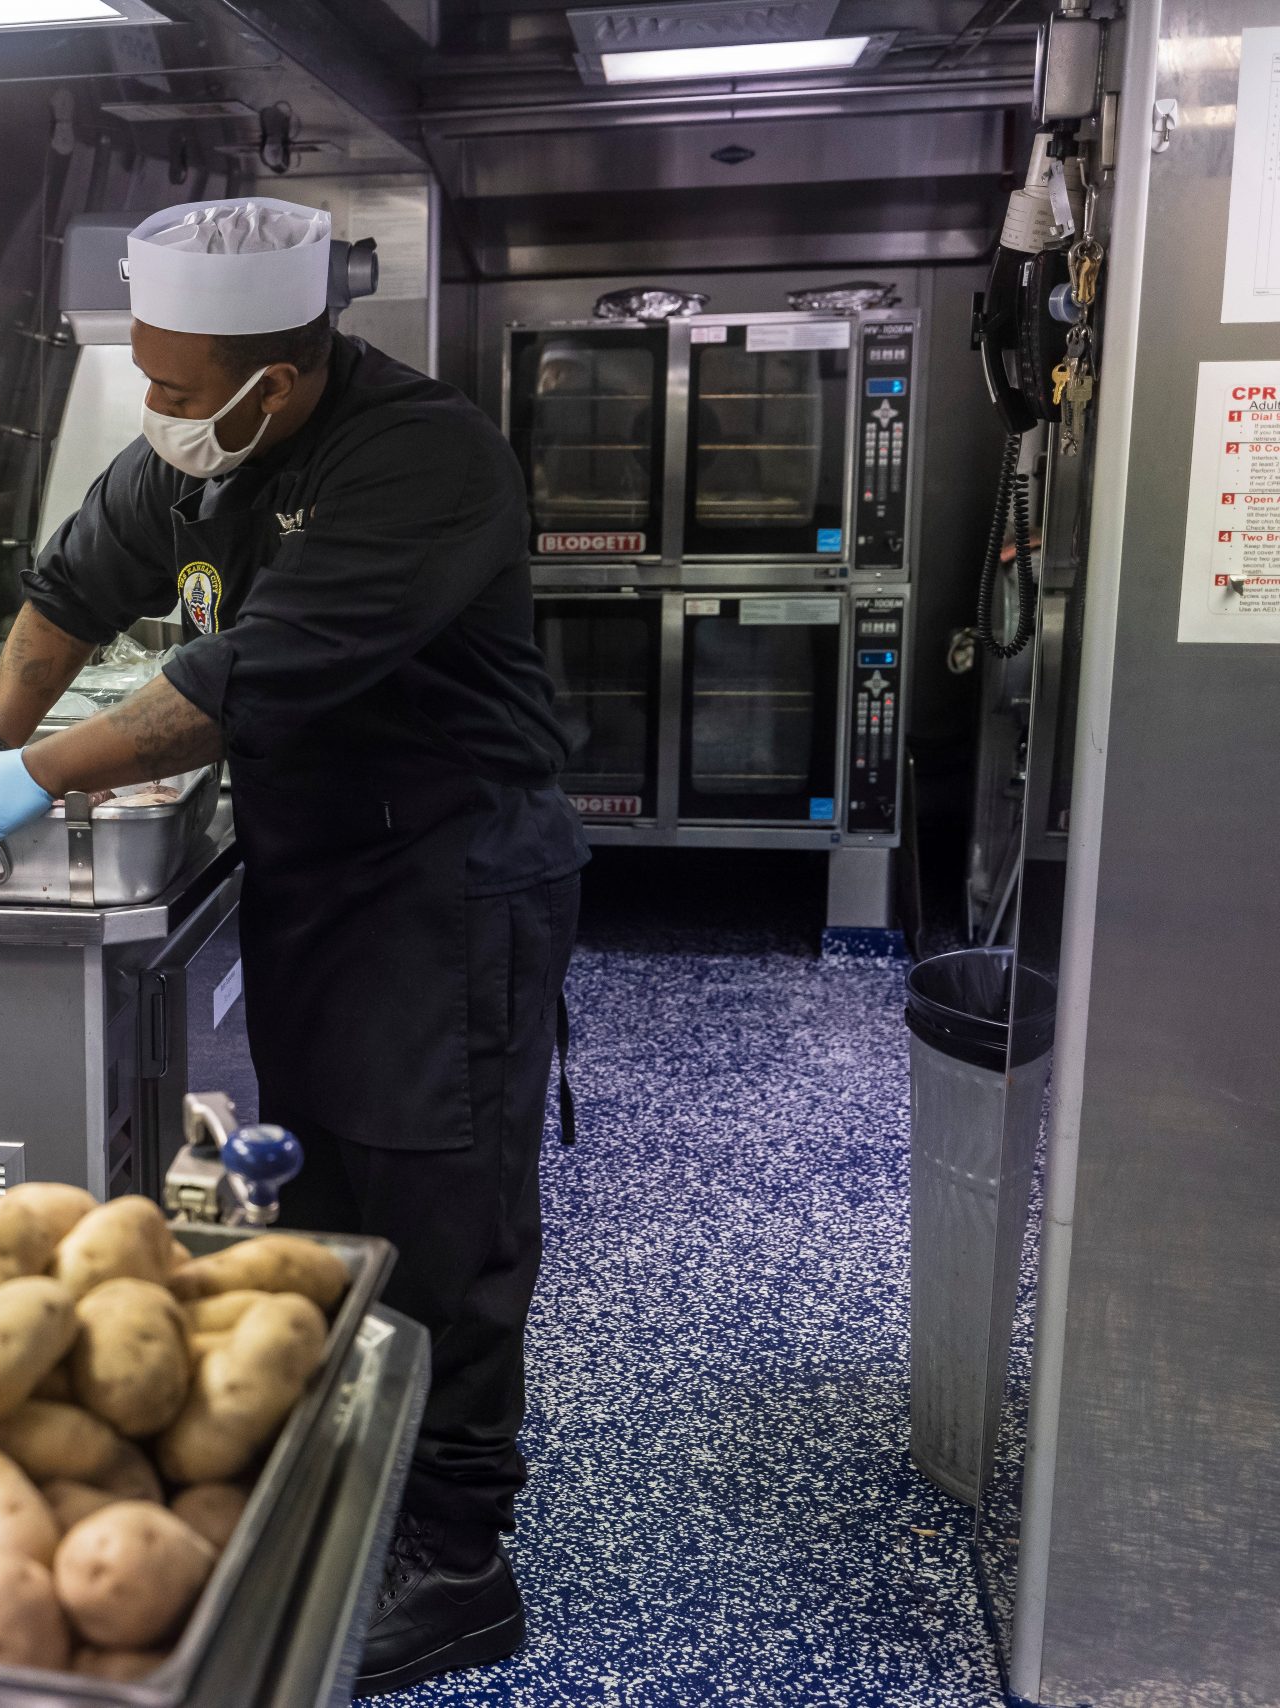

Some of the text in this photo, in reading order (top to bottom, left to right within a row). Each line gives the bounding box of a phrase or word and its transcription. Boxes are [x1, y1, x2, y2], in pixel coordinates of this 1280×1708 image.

[1232, 387, 1276, 400] CPR
[1229, 445, 1236, 453] 2
[1225, 495, 1232, 503] 3
[1245, 495, 1273, 504] Open
[1221, 533, 1229, 541] 4
[544, 535, 638, 551] BLODGETT
[1218, 577, 1225, 585] 5
